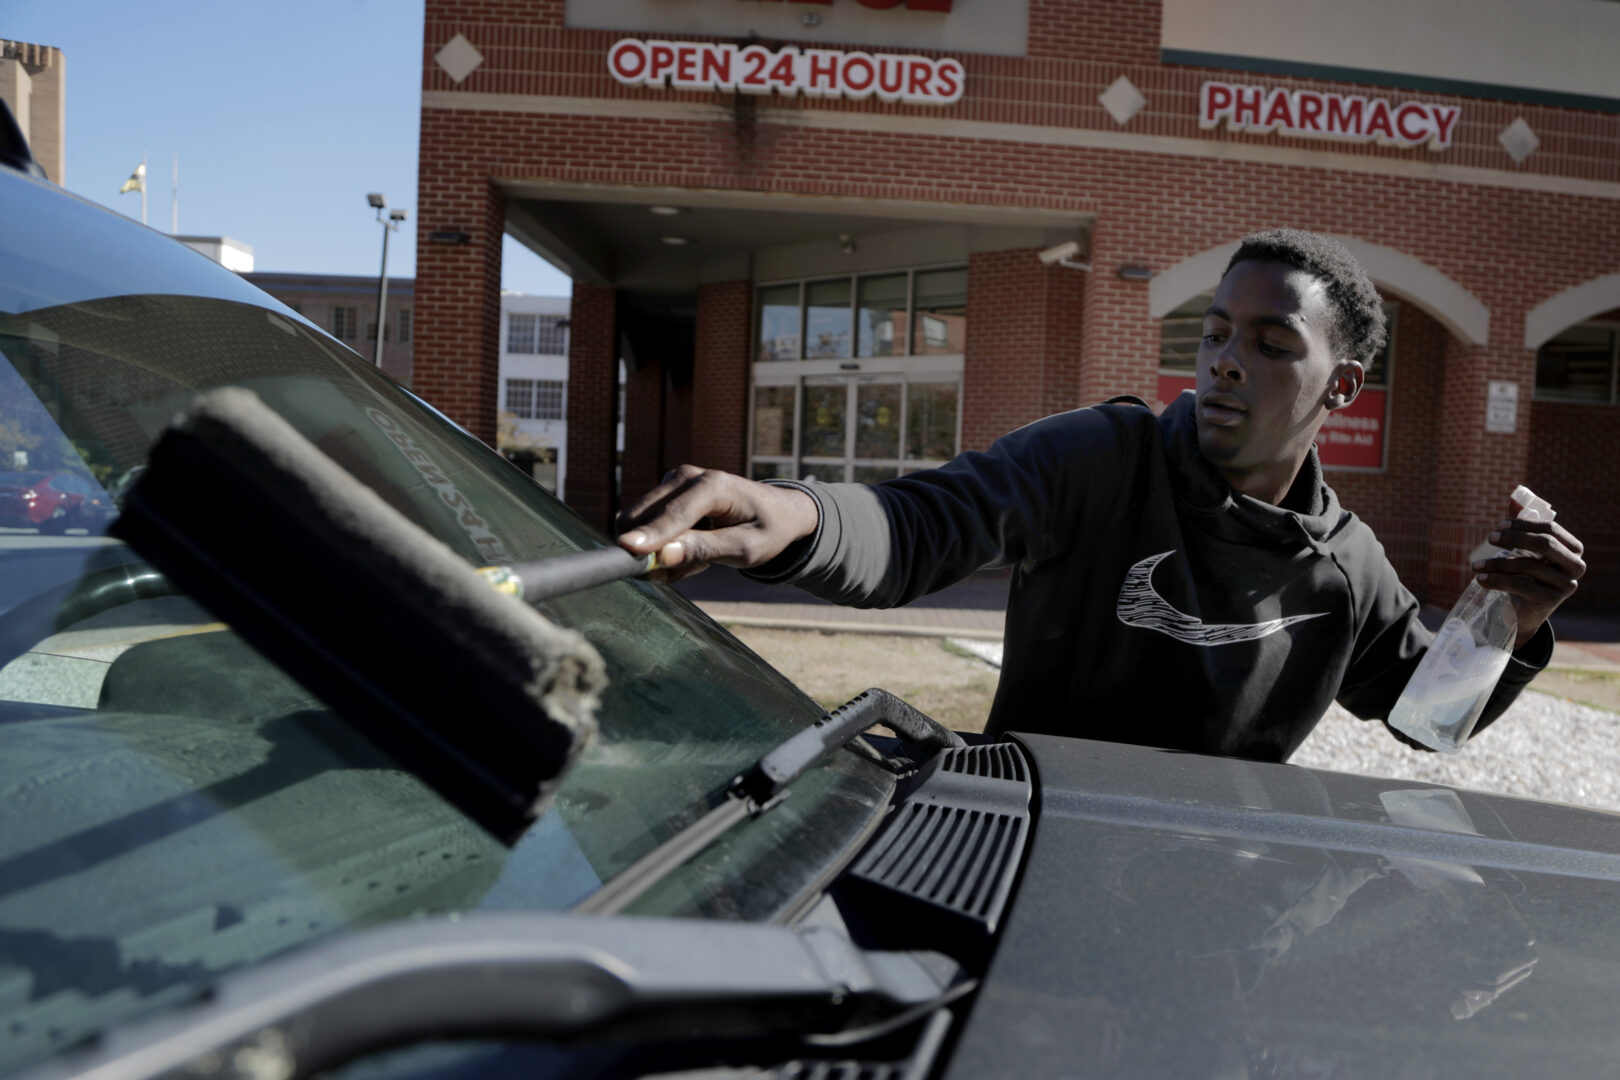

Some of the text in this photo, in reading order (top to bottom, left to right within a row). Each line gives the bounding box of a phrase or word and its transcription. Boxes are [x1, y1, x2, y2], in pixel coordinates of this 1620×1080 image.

[612, 43, 960, 98] OPEN 24 HOURS
[1206, 85, 1456, 143] PHARMACY
[1322, 413, 1379, 430] ellness
